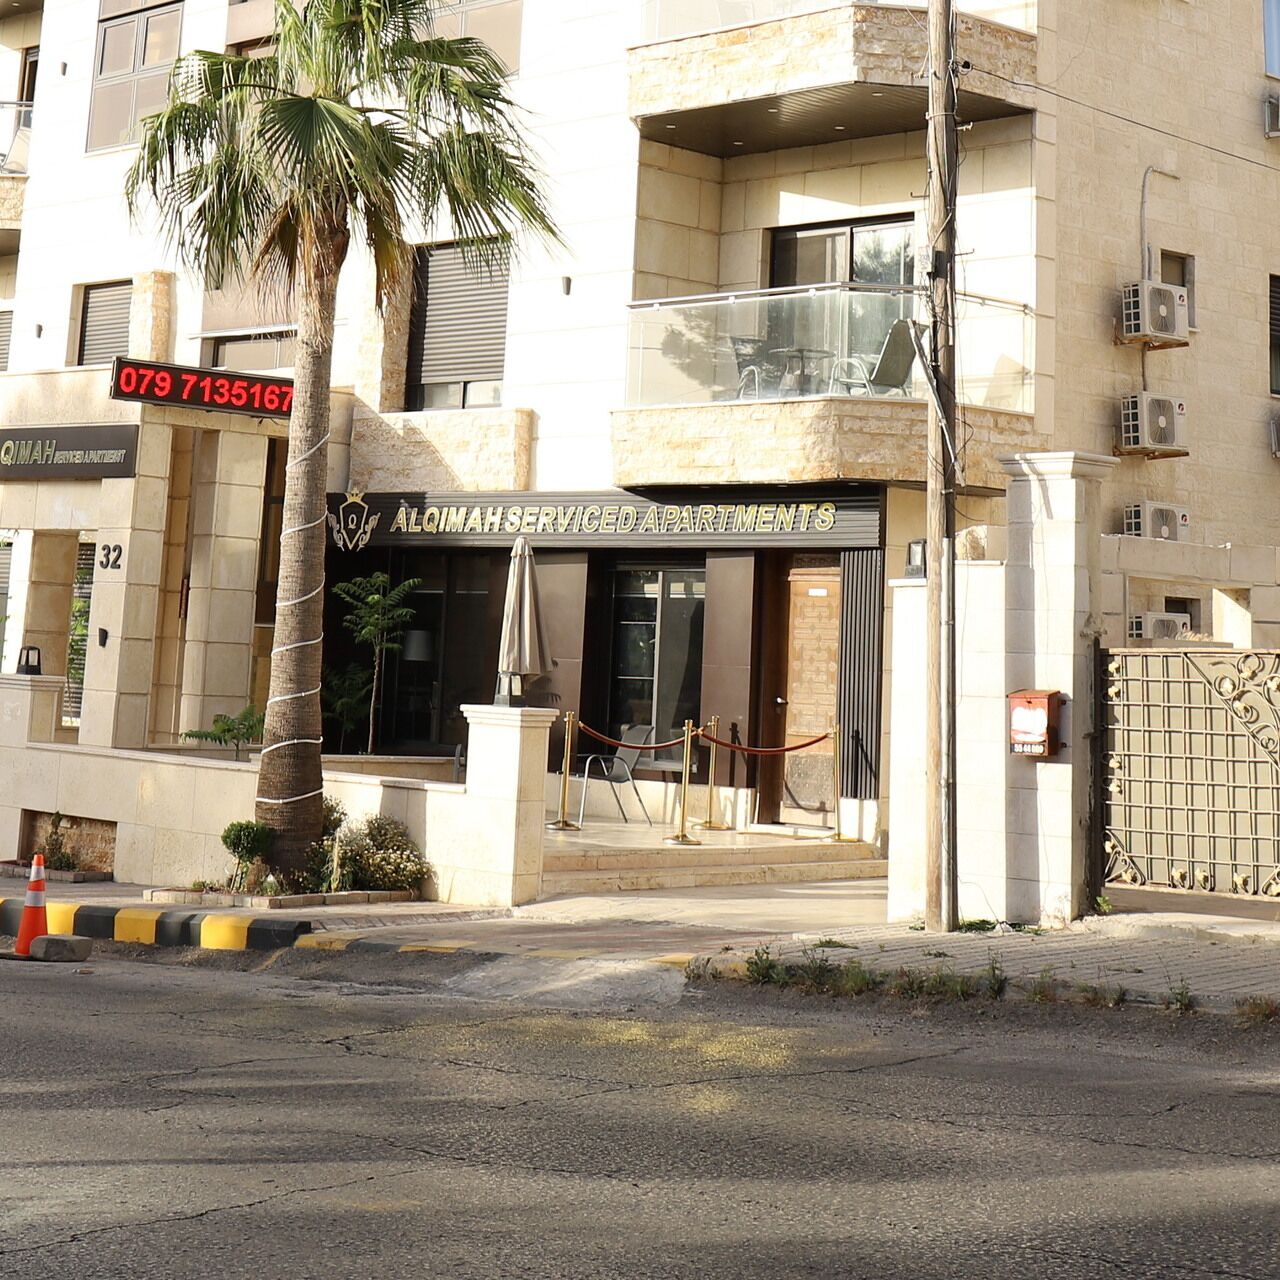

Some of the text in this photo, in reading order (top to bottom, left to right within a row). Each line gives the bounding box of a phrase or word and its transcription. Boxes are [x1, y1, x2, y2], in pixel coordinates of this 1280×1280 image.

[120, 366, 294, 412] 079 7135167
[390, 502, 836, 533] ALQIMAH SERVICED APARTMENTS
[99, 544, 121, 570] 32
